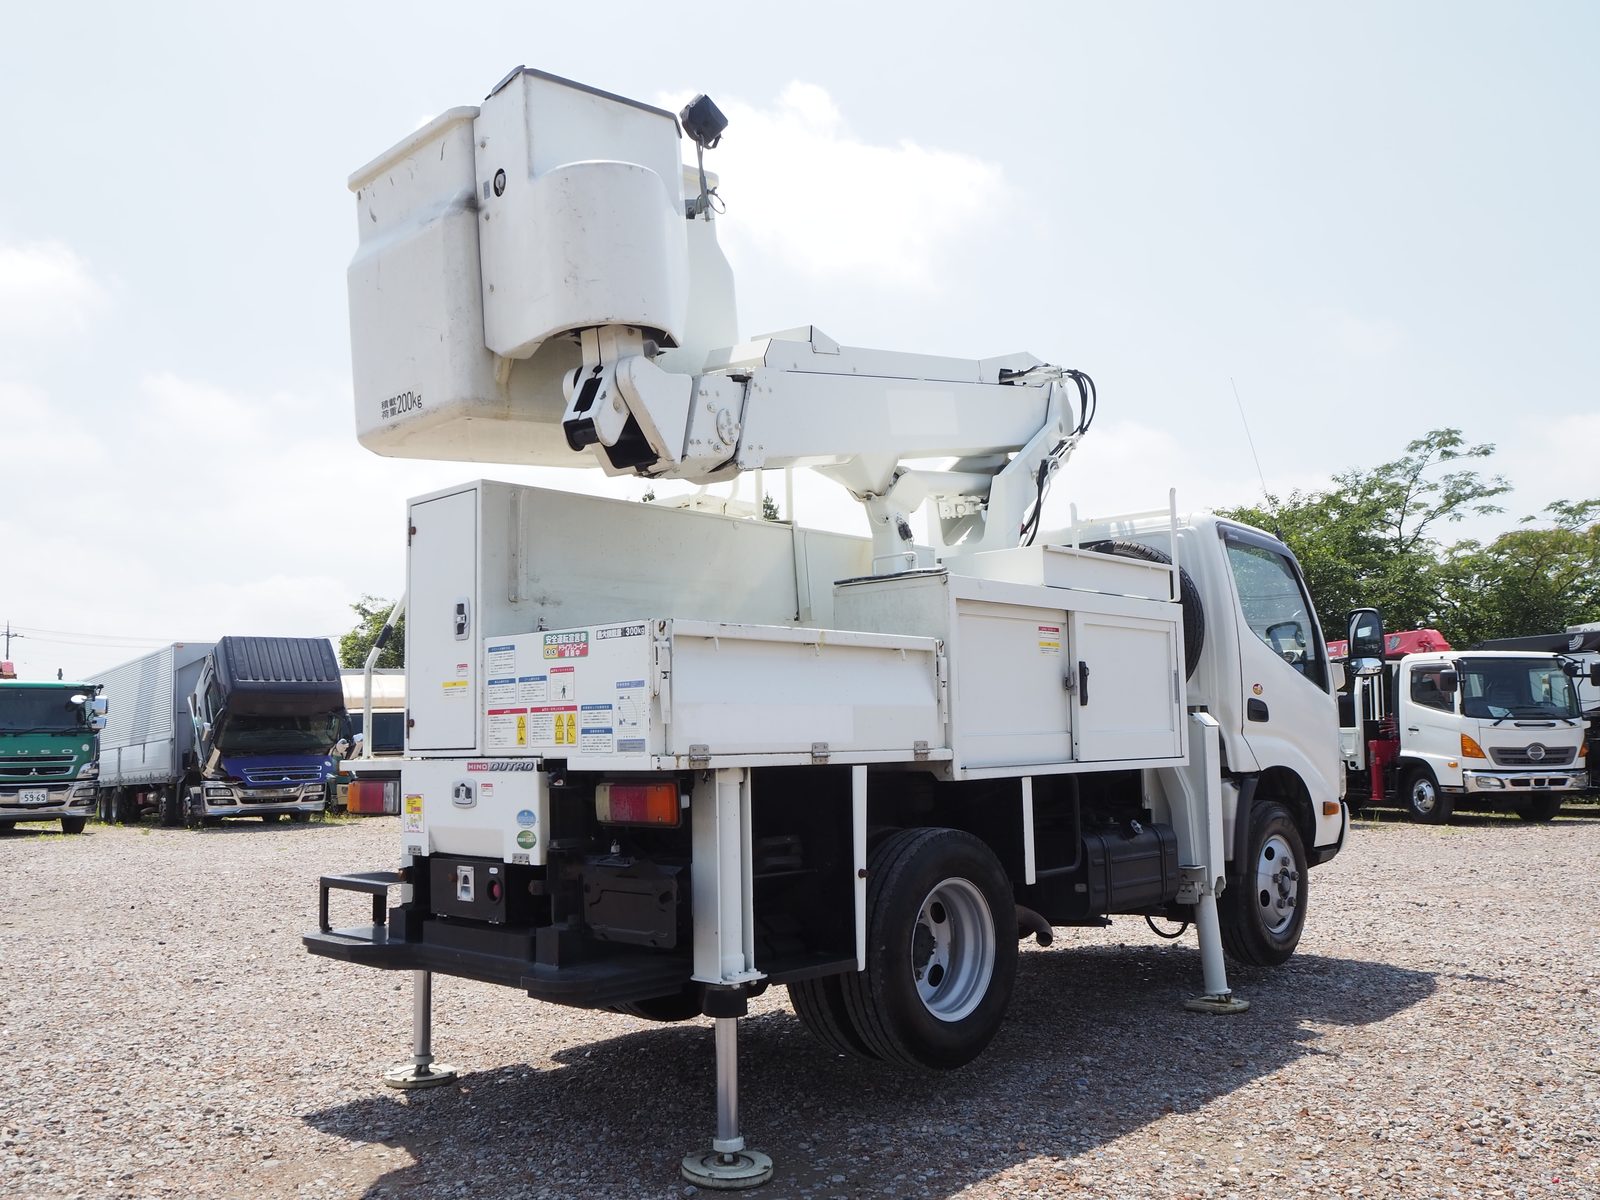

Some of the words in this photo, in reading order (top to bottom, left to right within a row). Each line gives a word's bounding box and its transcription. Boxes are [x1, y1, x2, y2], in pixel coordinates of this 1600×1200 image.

[397, 391, 422, 414] 200kg
[625, 625, 645, 637] 300kg
[545, 632, 587, 645] 安全運転宣言車
[468, 763, 488, 771] HINO
[489, 762, 534, 771] DUTRO
